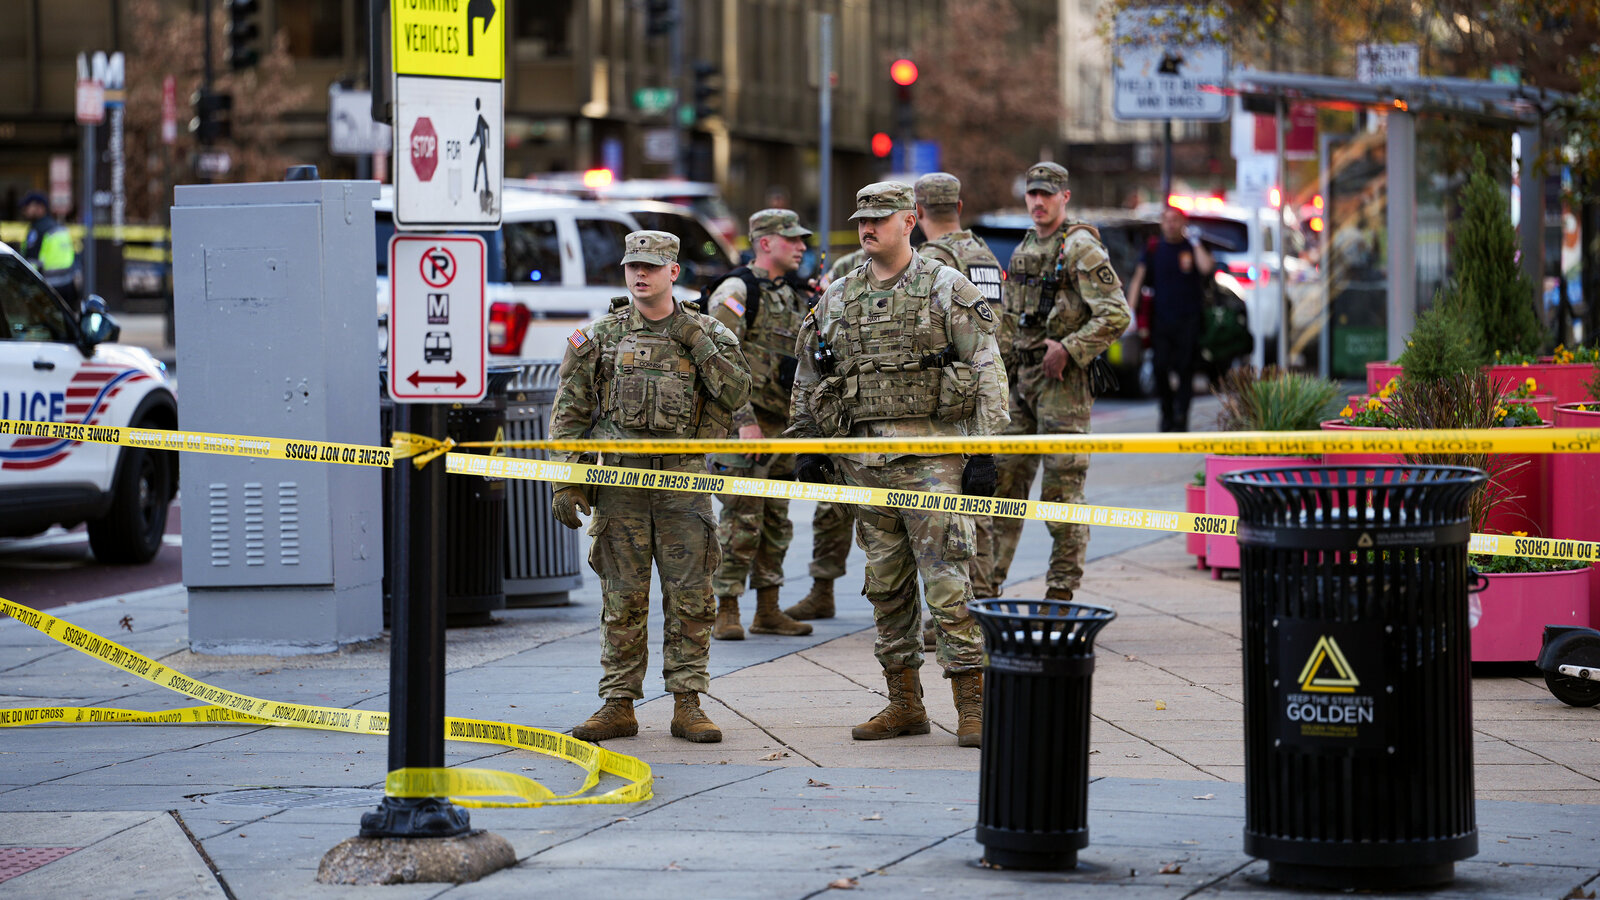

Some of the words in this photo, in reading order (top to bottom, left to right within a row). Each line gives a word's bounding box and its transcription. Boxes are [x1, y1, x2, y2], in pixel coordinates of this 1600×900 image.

[405, 24, 459, 54] VEHICLES
[413, 136, 435, 158] STOP
[446, 140, 461, 160] FOR
[970, 267, 1001, 284] NATIONAL
[639, 361, 663, 369] CORNISH
[14, 422, 33, 435] NOT
[35, 423, 49, 437] DO
[53, 425, 84, 440] SCENE
[87, 427, 120, 442] CRIME
[129, 431, 162, 447] CROSS
[165, 433, 185, 448] NOT
[187, 434, 201, 449] DO
[203, 436, 236, 452] SCENE
[238, 438, 270, 455] CRIME
[285, 442, 318, 460] CROSS
[320, 446, 340, 461] NOT
[342, 448, 356, 463] DO
[358, 449, 390, 466] SCENE
[447, 455, 465, 472] CRO
[467, 457, 488, 473] NOT
[489, 459, 503, 475] DO
[505, 461, 537, 478] SCENE
[540, 463, 572, 480] CRIME
[585, 468, 618, 484] CROSS
[620, 471, 640, 486] NOT
[642, 473, 656, 486] DO
[658, 475, 690, 489] SCENE
[692, 477, 724, 492] CRIME
[732, 480, 765, 495] CROSS
[767, 482, 788, 497] NOT
[789, 483, 803, 498] DO
[805, 485, 838, 500] SCENE
[838, 487, 872, 503] CRIME
[886, 492, 919, 508] CROSS
[921, 495, 941, 509] NOT
[943, 496, 958, 510] DO
[960, 498, 992, 513] SCENE
[994, 501, 1027, 516] CRIME
[1035, 503, 1069, 519] CROSS
[1071, 506, 1092, 522] NOT
[1094, 508, 1108, 523] DO
[1110, 510, 1143, 527] SCENE
[1145, 511, 1179, 529] CRIME
[1193, 516, 1227, 534] CROSS
[1469, 534, 1498, 552] CRIM
[1514, 539, 1550, 556] CROSS
[1552, 541, 1573, 557] NOT
[1577, 543, 1592, 558] DO
[1, 603, 17, 618] LINE
[17, 608, 42, 629] POLICE
[63, 627, 87, 647] CROSS
[85, 636, 102, 654] NOT
[99, 642, 113, 658] DO
[109, 647, 128, 665] LINE
[124, 655, 151, 675] POLICE
[168, 675, 193, 692] CROSS
[190, 684, 208, 697] NOT
[204, 689, 217, 701] DO
[214, 692, 232, 706] LINE
[1287, 694, 1309, 704] KEEP
[1312, 695, 1329, 705] THE
[1331, 696, 1374, 706] STREETS
[229, 696, 256, 712] POLICE
[12, 710, 22, 722] DO
[24, 709, 39, 721] NOT
[41, 708, 64, 719] CROSS
[90, 710, 115, 722] POLICE
[272, 705, 296, 720] CROSS
[293, 708, 309, 722] NOT
[307, 710, 318, 723] DO
[316, 710, 331, 725] LINE
[330, 711, 351, 727] POLICE
[1287, 703, 1374, 723] GOLDEN
[369, 715, 388, 731] CROSS
[451, 721, 465, 737] CROSS
[466, 723, 475, 738] NOT
[475, 723, 482, 738] DO
[481, 724, 492, 739] LINE
[491, 725, 505, 741] POLICE
